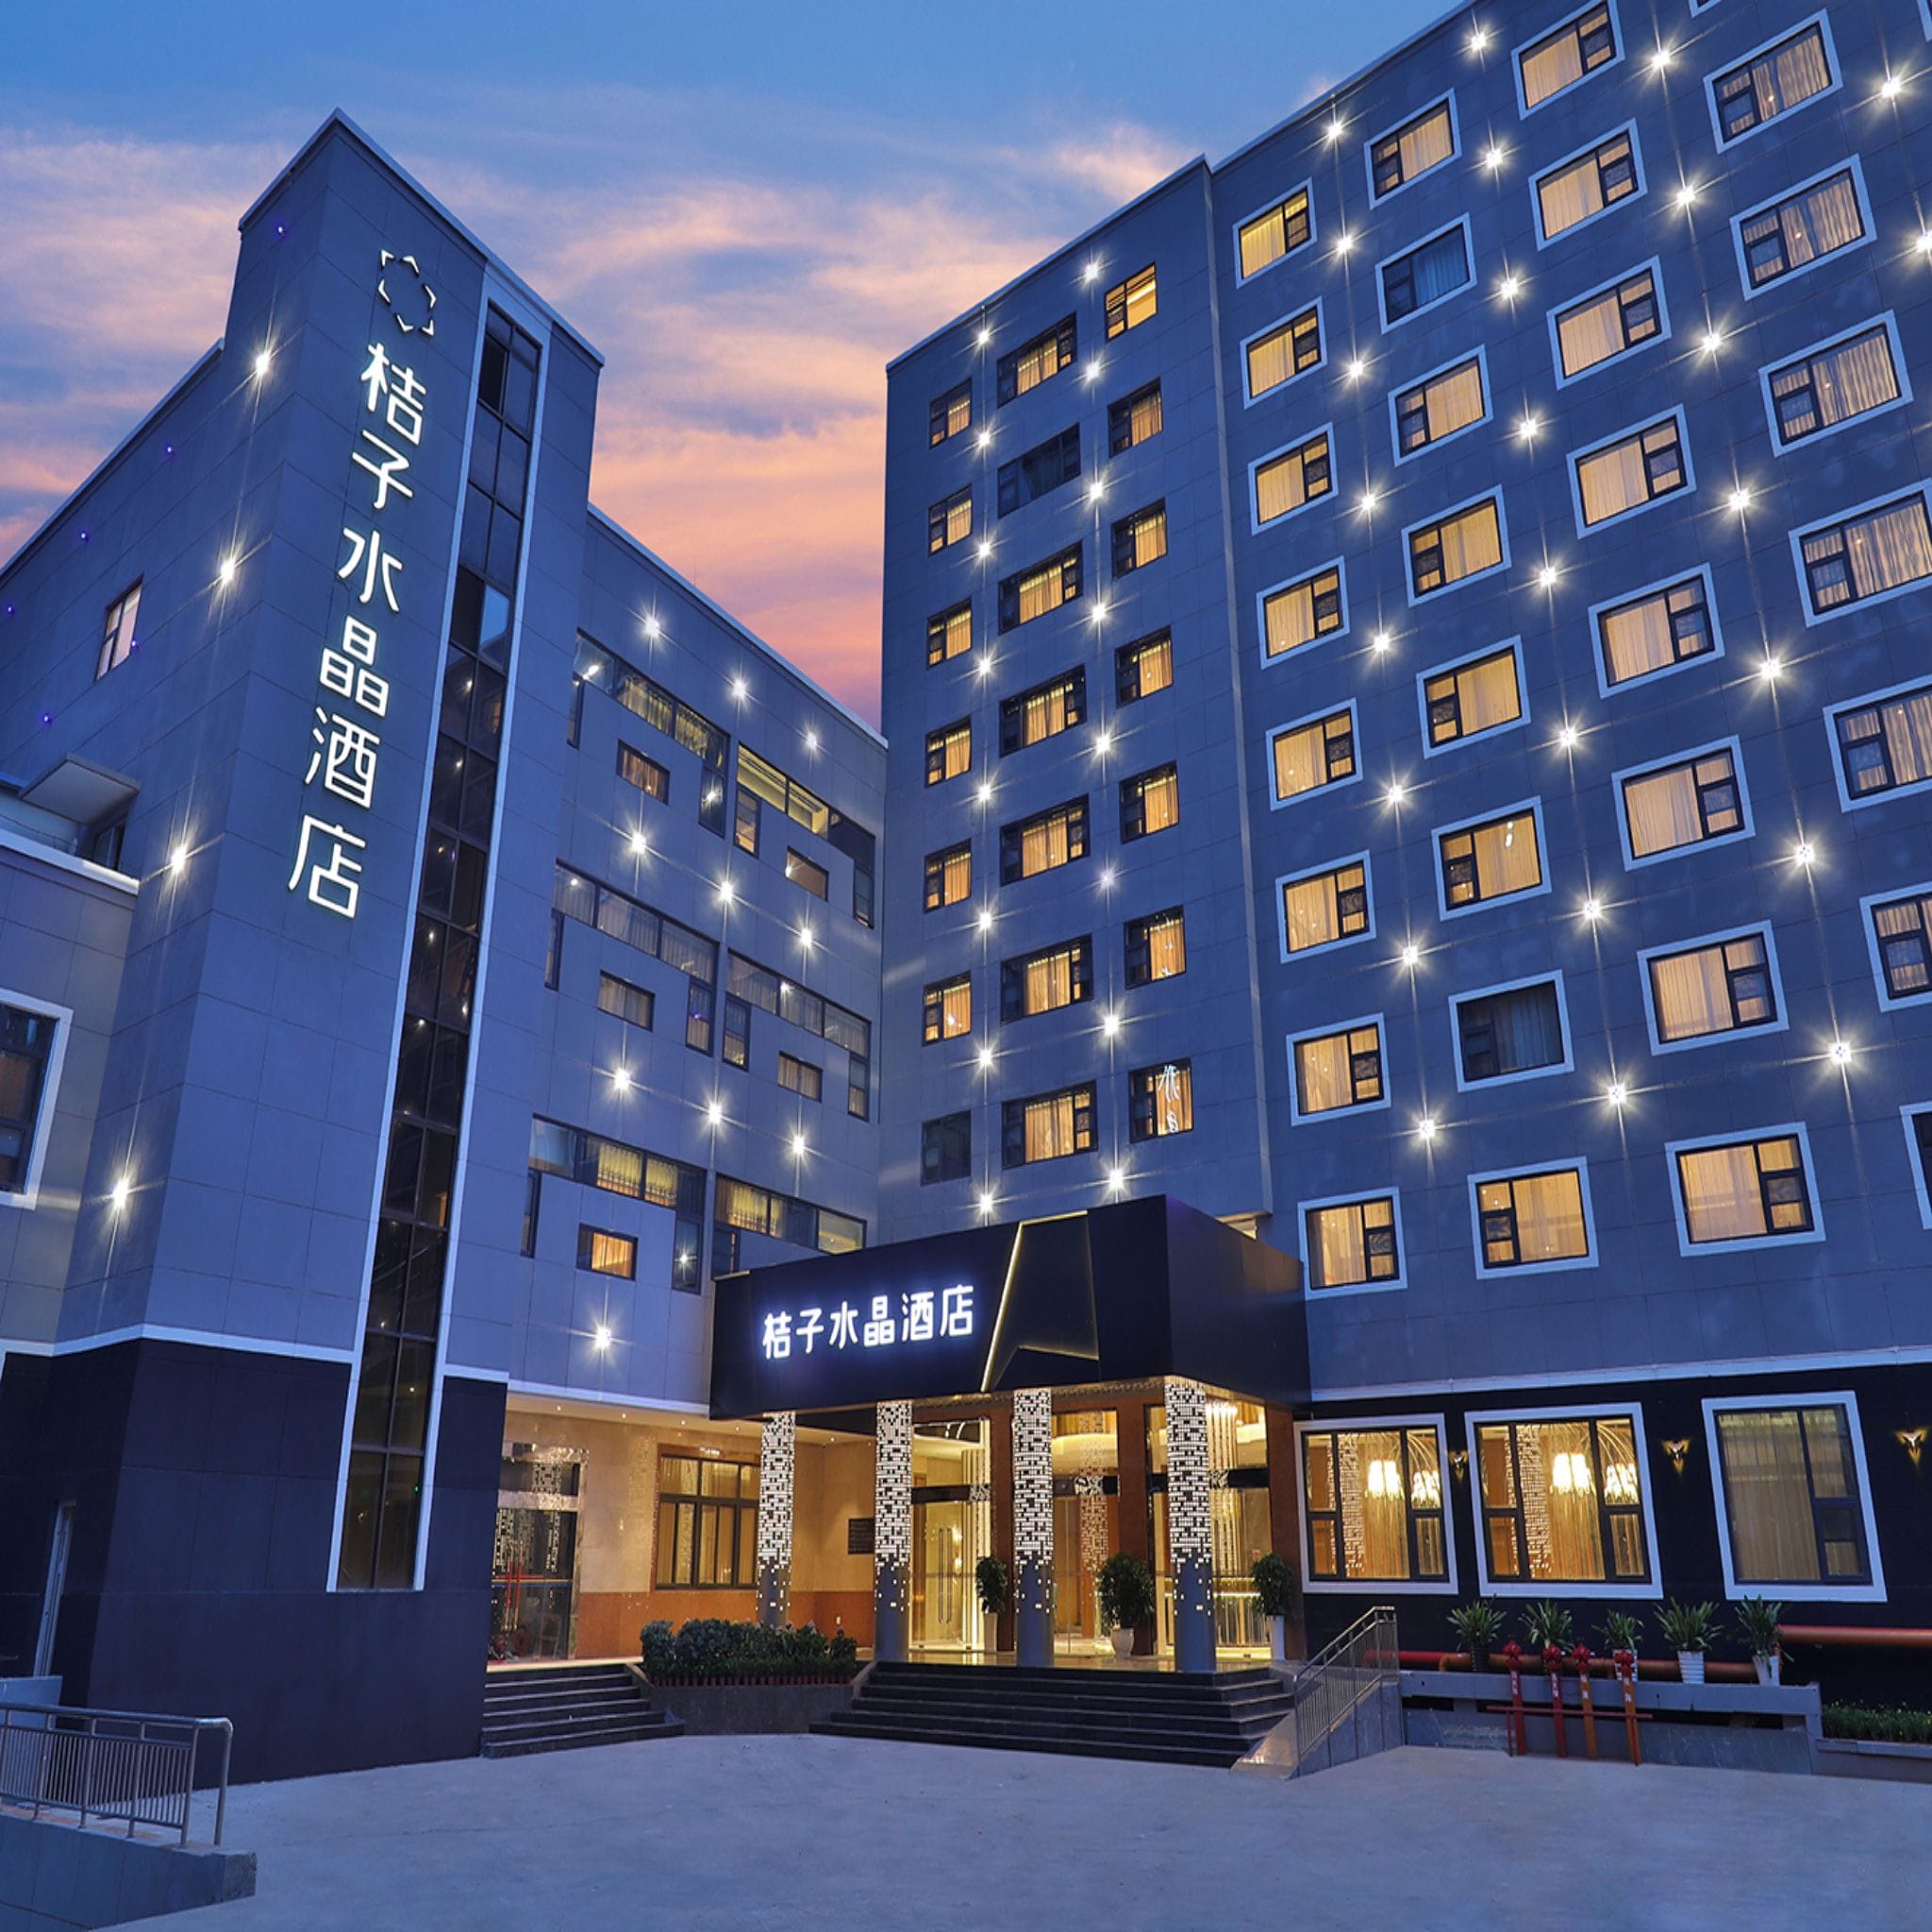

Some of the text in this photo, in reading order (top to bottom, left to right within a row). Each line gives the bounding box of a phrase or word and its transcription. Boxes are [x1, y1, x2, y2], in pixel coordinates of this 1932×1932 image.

[289, 342, 427, 919] 桔子水晶酒店
[761, 1284, 974, 1359] 桔子水晶酒店
